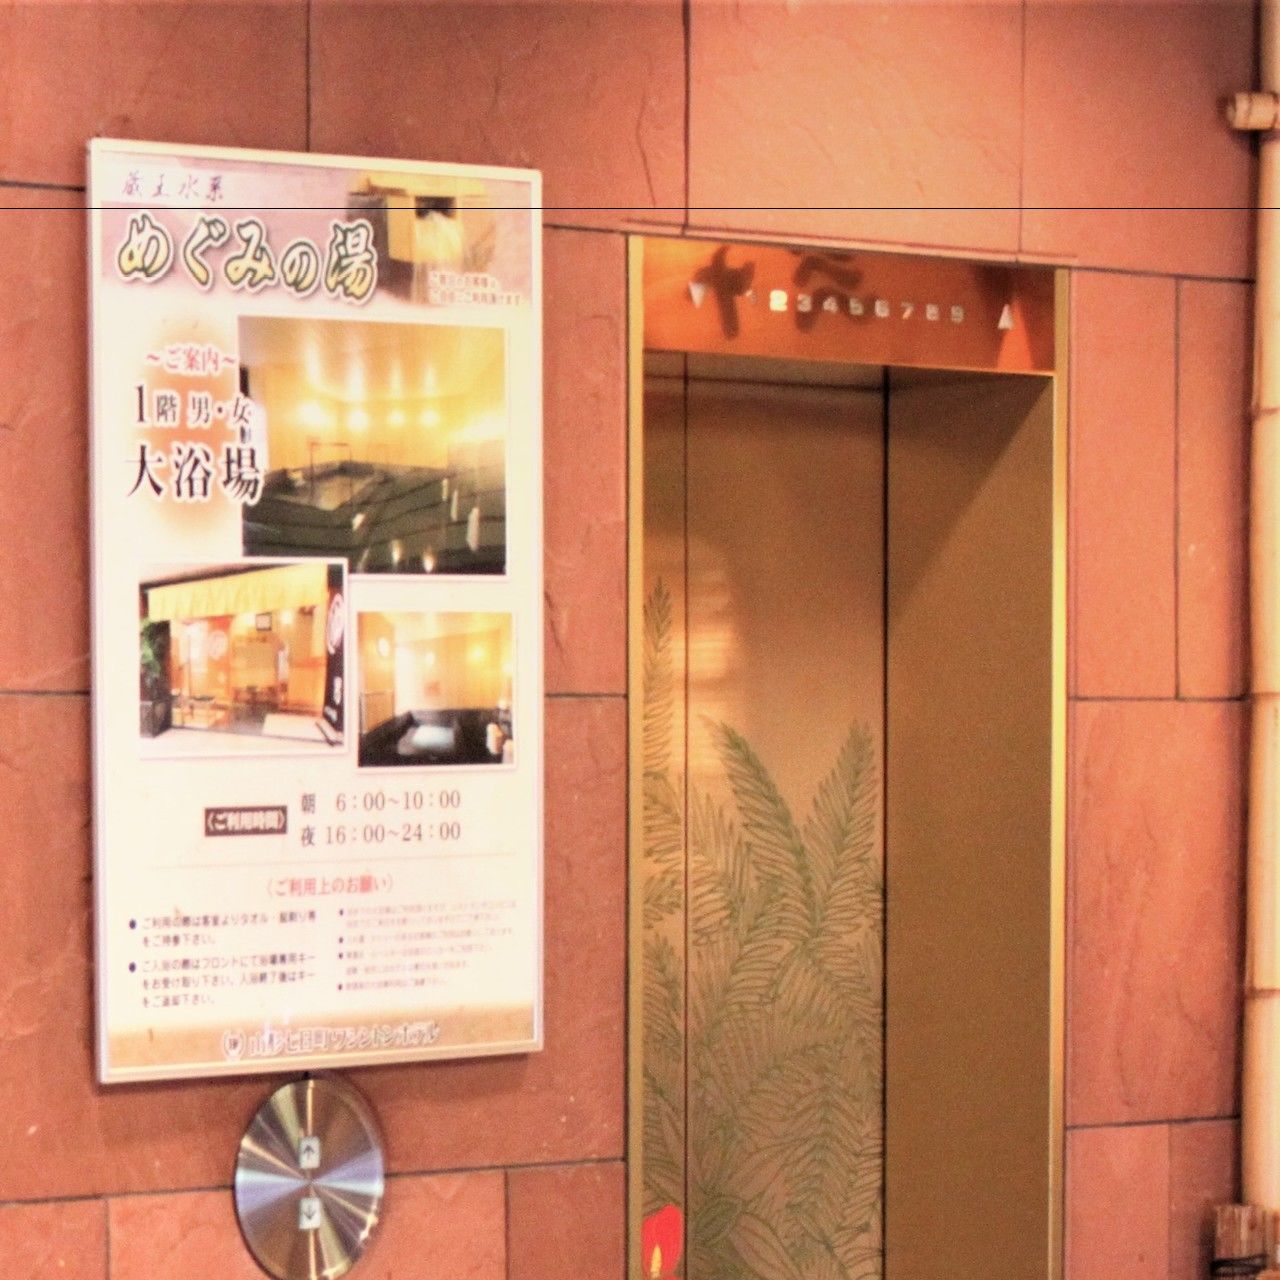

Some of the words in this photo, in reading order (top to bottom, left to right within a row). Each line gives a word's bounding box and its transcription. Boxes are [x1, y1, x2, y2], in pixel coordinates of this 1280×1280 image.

[118, 213, 377, 302] めぐみの湯
[135, 385, 178, 425] 1階
[126, 445, 263, 501] 大浴場
[301, 793, 317, 813] 朝
[300, 826, 316, 847] 夜
